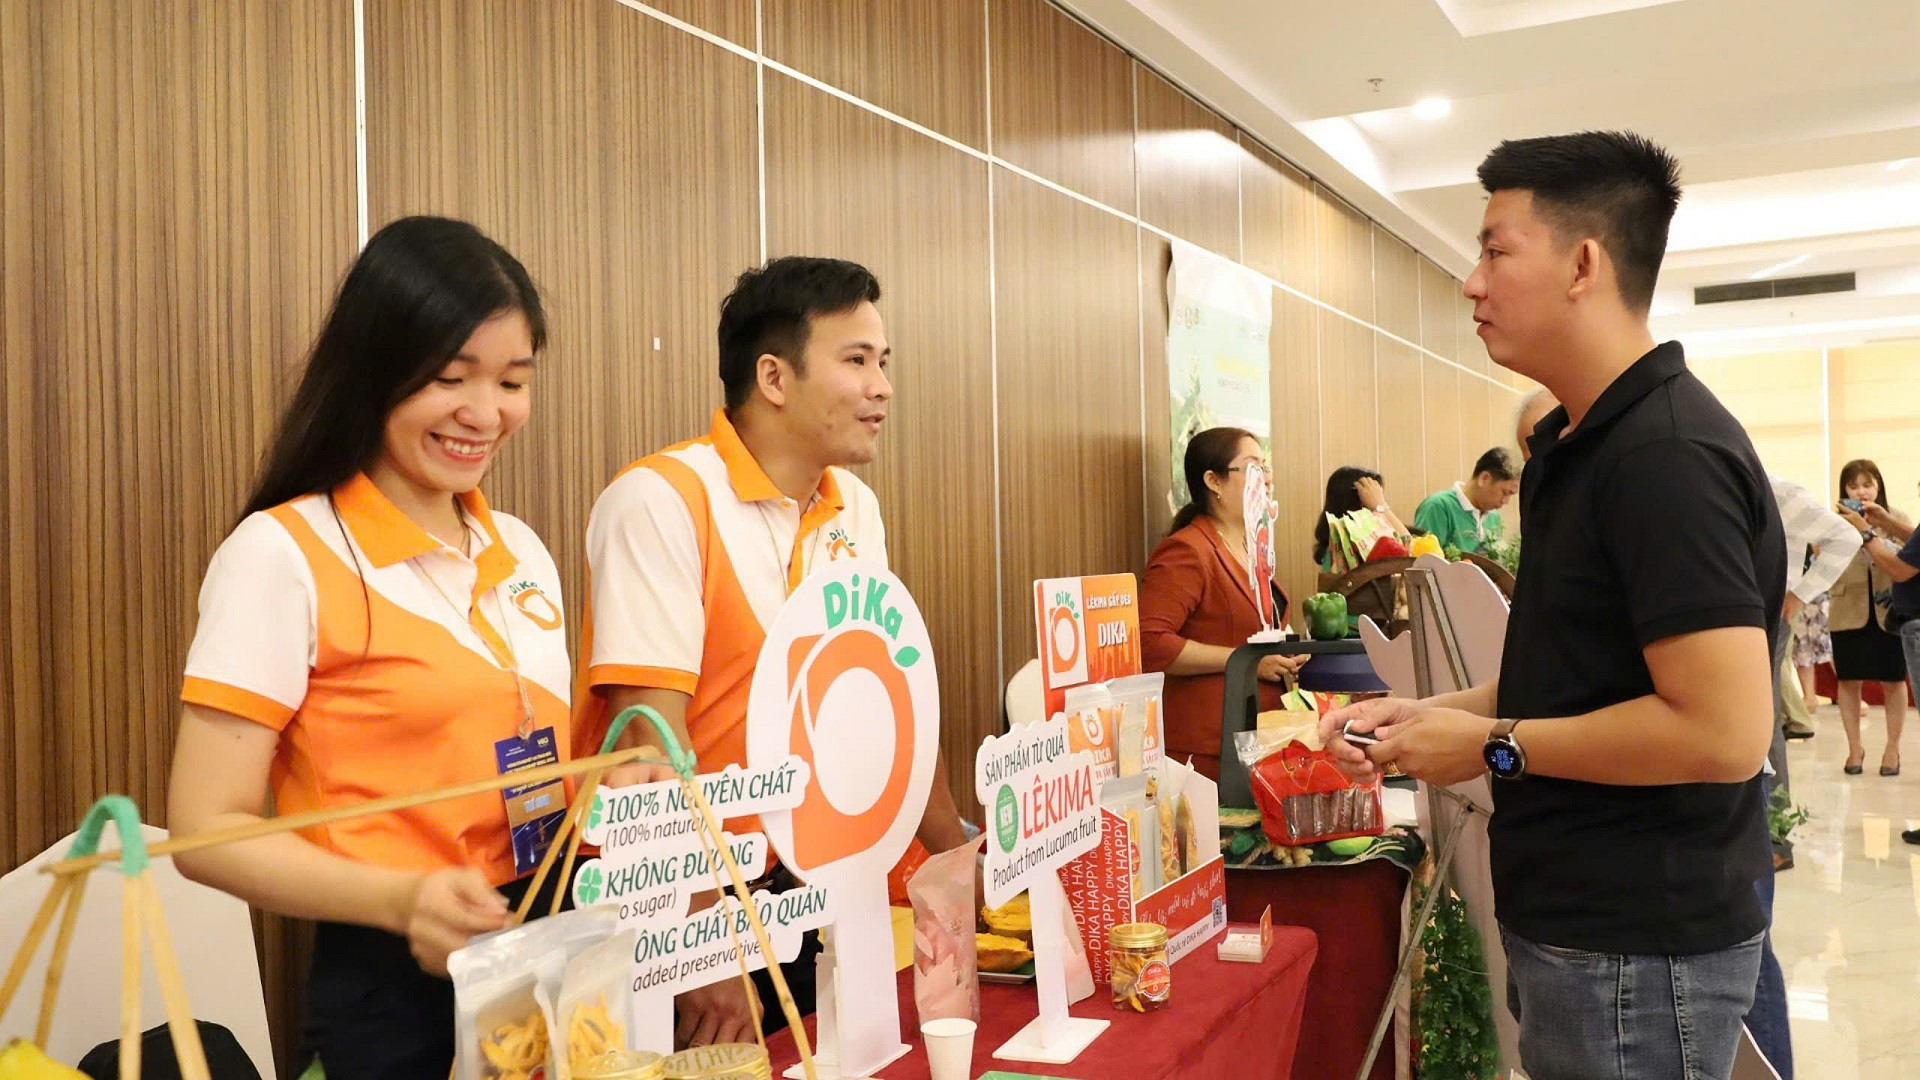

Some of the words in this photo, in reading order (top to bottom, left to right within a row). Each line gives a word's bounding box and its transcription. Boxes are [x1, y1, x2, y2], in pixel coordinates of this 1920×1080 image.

[823, 573, 903, 640] DiKa
[1056, 591, 1074, 610] DiKa
[1098, 620, 1128, 648] DIKA
[985, 753, 1002, 787] SẢN
[1004, 739, 1030, 777] PHẨM
[1031, 736, 1044, 766] TỪ
[1045, 727, 1065, 762] QUẢ
[606, 791, 659, 824] 100%
[749, 762, 797, 799] CHẤT
[1022, 764, 1094, 840] LÊKIMA
[605, 818, 657, 852] (100%
[1104, 834, 1113, 867] HAPPY
[1114, 820, 1128, 870] HAPPY
[993, 856, 1024, 892] Product
[1025, 845, 1045, 870] from
[1046, 826, 1079, 858] Lucuma
[1079, 815, 1097, 843] fruit
[605, 856, 678, 898] KHÔNG
[1086, 861, 1100, 910] HAPPY
[1106, 867, 1114, 889] DIKA
[1117, 874, 1130, 910] DIKA
[632, 887, 676, 918] sugar)
[1072, 890, 1086, 925] DIKA
[635, 927, 678, 964] ÔNG
[683, 905, 733, 950] CHẤT
[777, 884, 827, 926] QUẢN
[1088, 915, 1100, 950] DIKA
[633, 958, 678, 993] added
[1094, 952, 1102, 982] HAPPY
